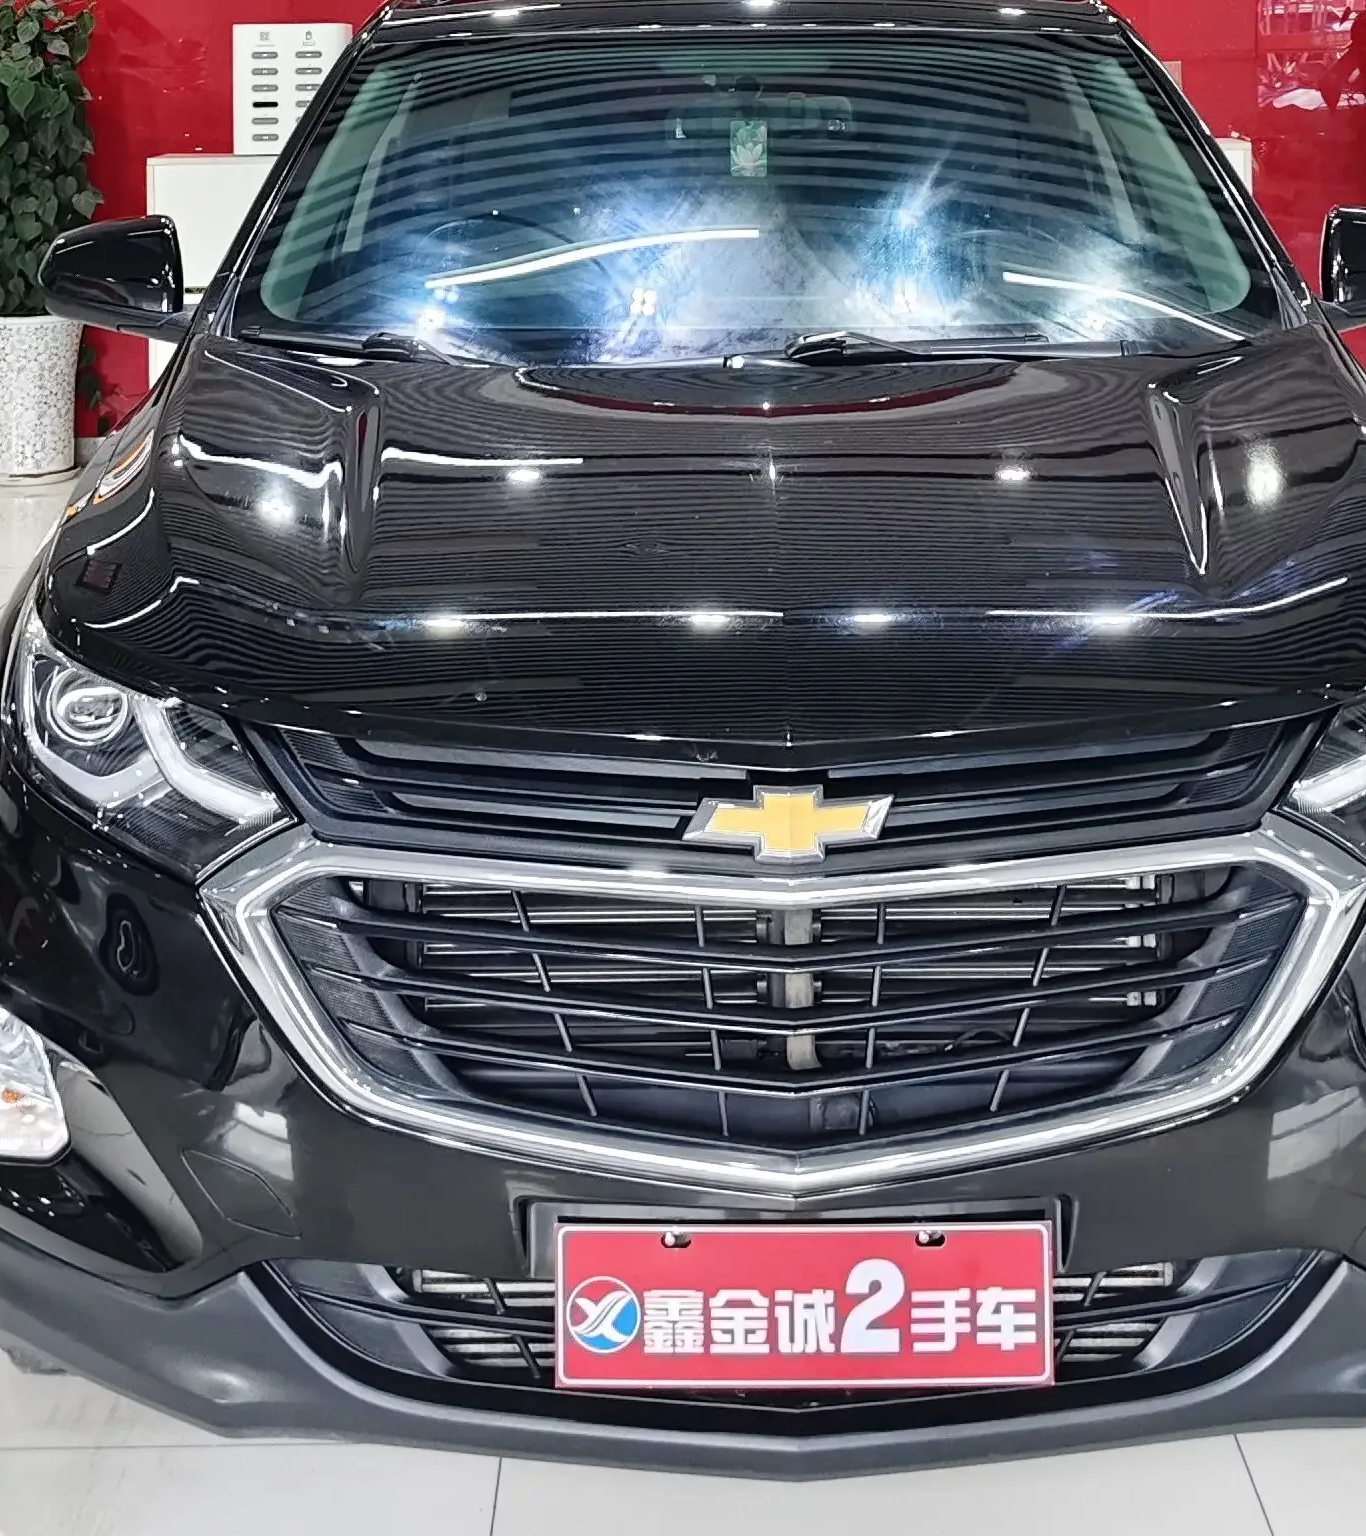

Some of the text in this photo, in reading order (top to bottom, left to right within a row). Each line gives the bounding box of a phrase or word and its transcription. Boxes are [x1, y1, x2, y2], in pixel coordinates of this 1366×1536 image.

[642, 1257, 1037, 1355] 鑫金诚2手车
